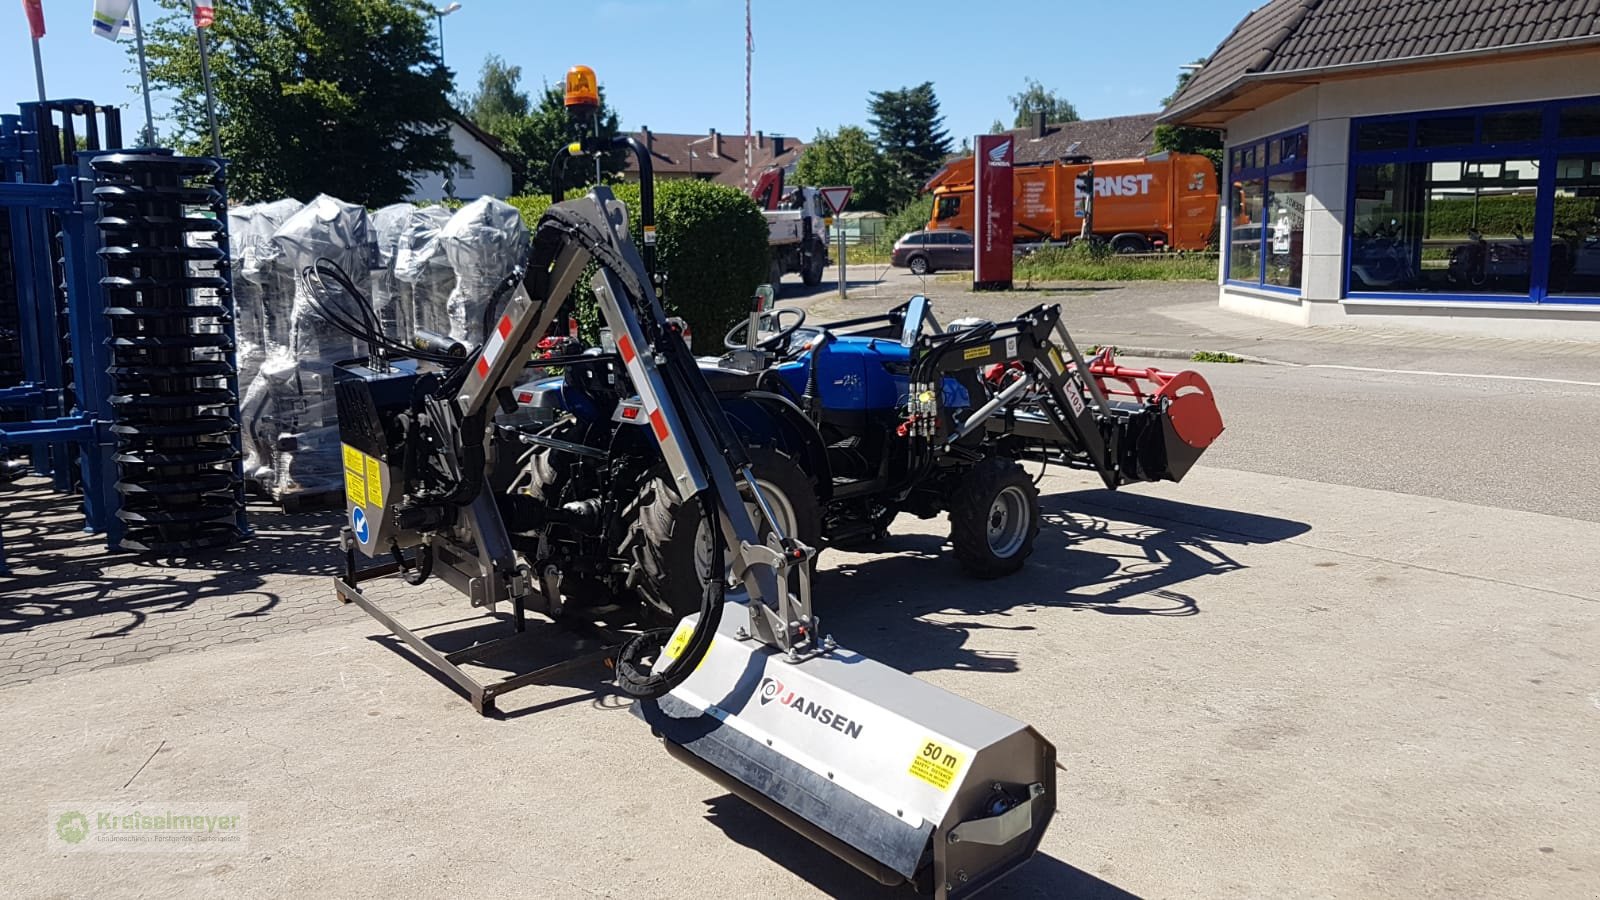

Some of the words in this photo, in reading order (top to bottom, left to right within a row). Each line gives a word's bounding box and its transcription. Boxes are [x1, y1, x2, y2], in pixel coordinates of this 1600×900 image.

[780, 692, 863, 740] JANSEN
[923, 742, 942, 760] 50
[942, 754, 957, 768] m
